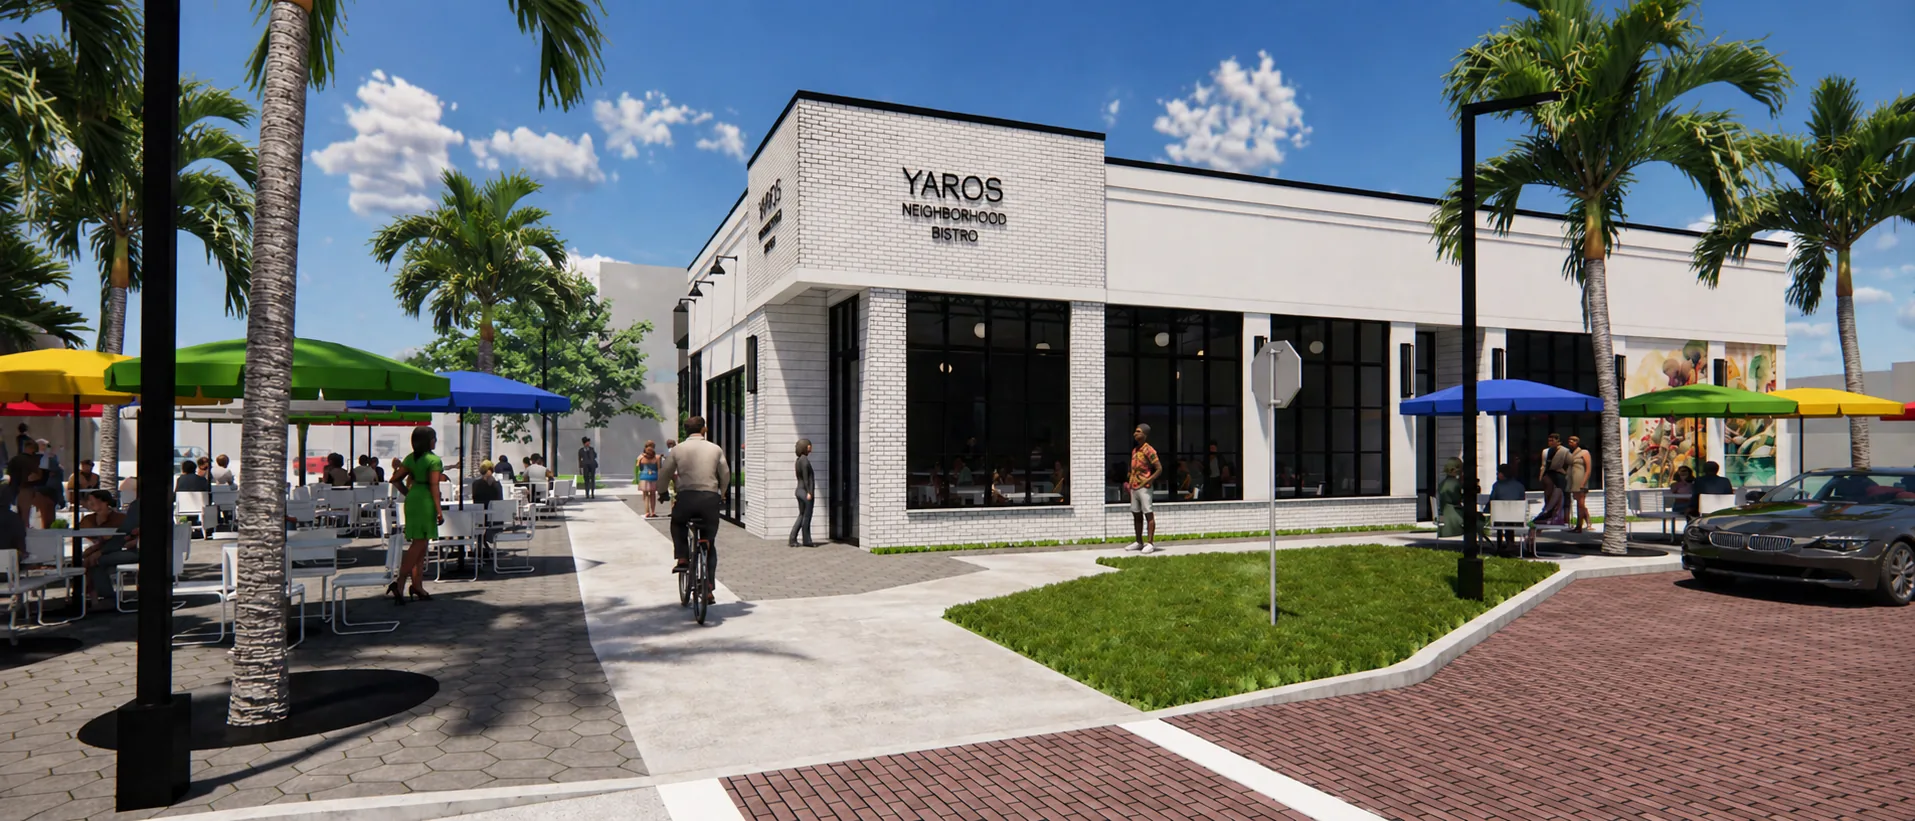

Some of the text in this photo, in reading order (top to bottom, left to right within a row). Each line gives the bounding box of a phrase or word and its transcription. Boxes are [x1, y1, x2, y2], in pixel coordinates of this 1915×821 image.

[902, 166, 1003, 202] YAROS
[902, 202, 1007, 225] NEIGHBORHOOD
[931, 225, 978, 242] BISTRO
